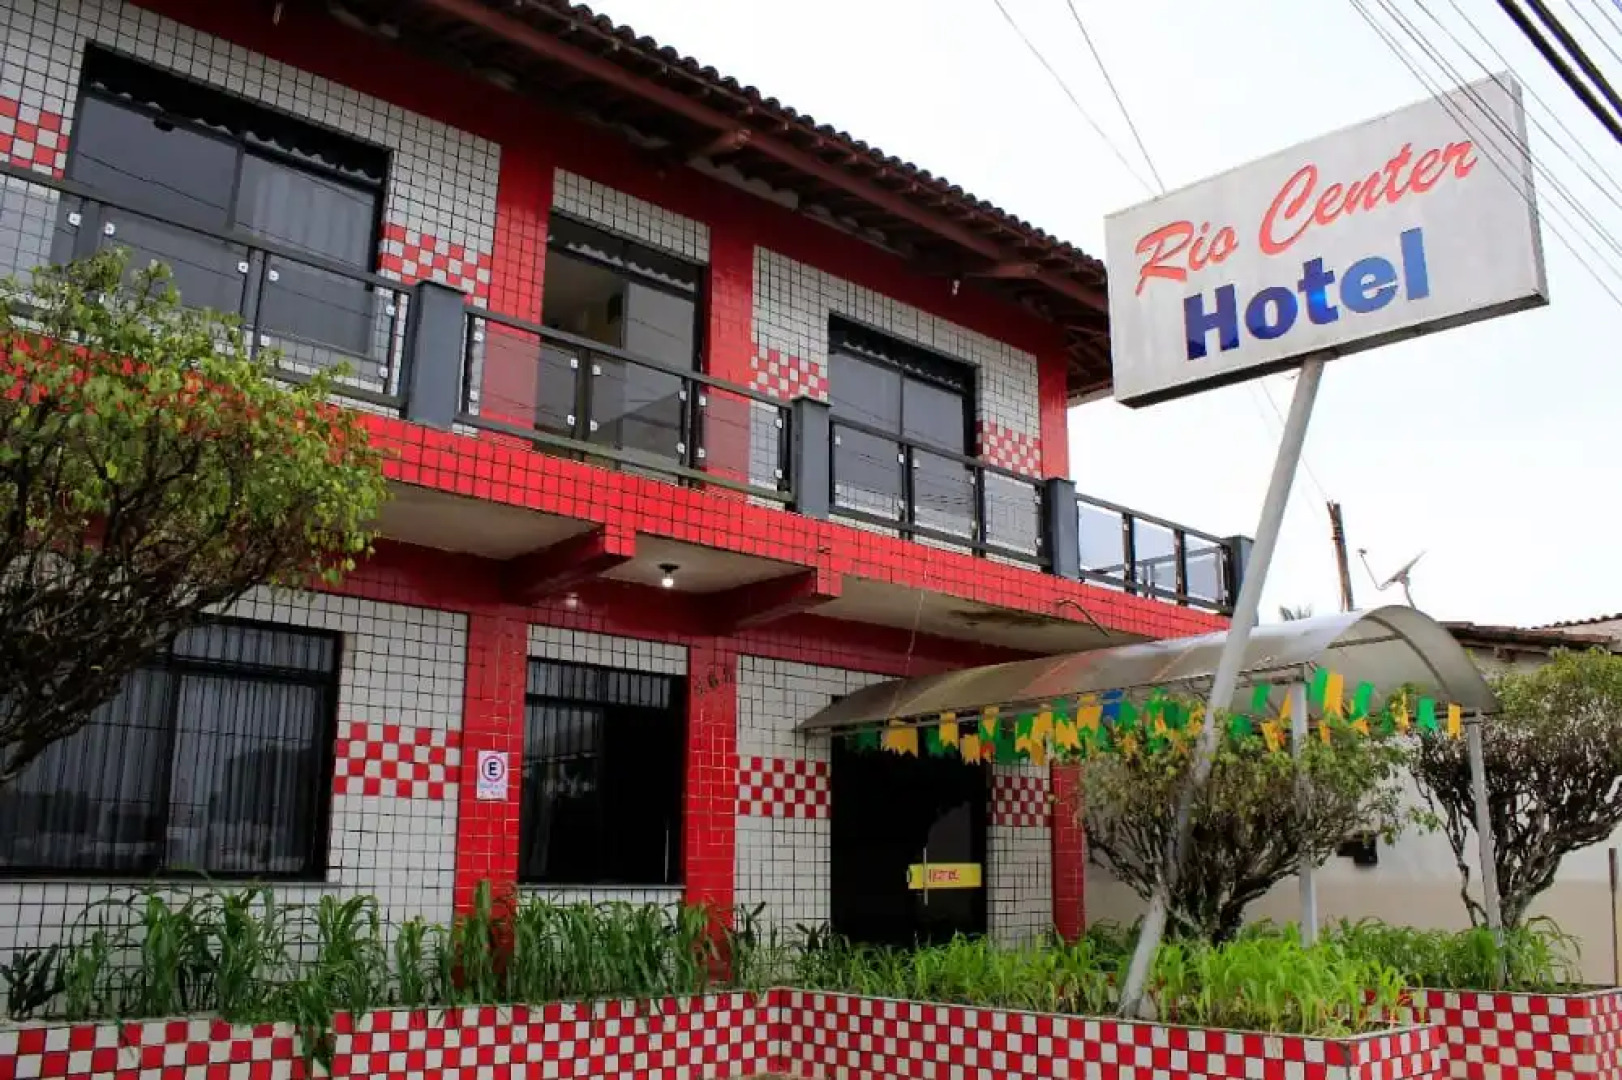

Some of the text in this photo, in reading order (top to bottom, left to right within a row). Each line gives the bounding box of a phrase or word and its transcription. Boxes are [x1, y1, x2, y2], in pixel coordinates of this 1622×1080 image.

[1135, 139, 1479, 297] Rio Center
[1183, 226, 1430, 361] Hotel
[487, 761, 498, 776] E
